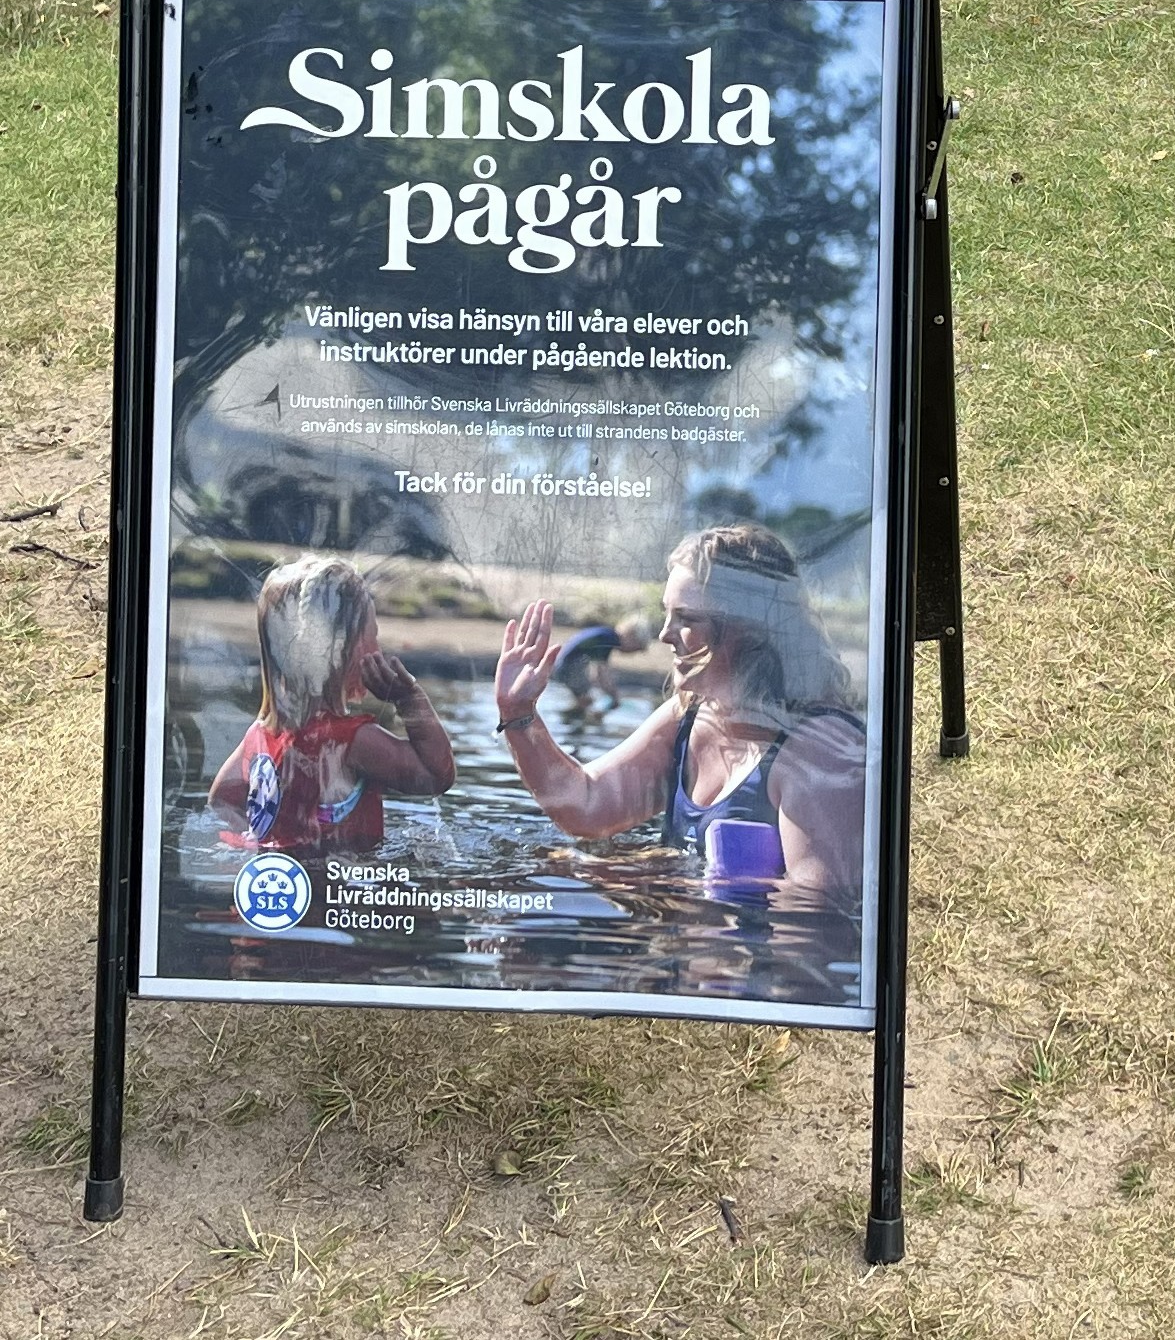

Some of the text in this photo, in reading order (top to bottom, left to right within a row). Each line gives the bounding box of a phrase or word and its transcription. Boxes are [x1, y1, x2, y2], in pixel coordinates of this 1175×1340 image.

[240, 44, 776, 146] Simskola
[378, 155, 683, 274] pågår
[305, 306, 749, 337] Vänligen visa hänsyn till våra elever och
[319, 339, 732, 372] instruktörer under pågående lektion.
[289, 394, 760, 421] Utrustningen tillhör Svenska Livräddningssällskapet Göteborg och
[300, 419, 748, 444] används av simskolan, de lånas inte ut till strandens badgäster.
[394, 470, 652, 498] Tack för din förståelse!
[326, 861, 410, 882] Svenska
[256, 895, 288, 911] SLS
[325, 885, 554, 914] Livräddningssällskapet
[325, 909, 415, 935] Göteborg
